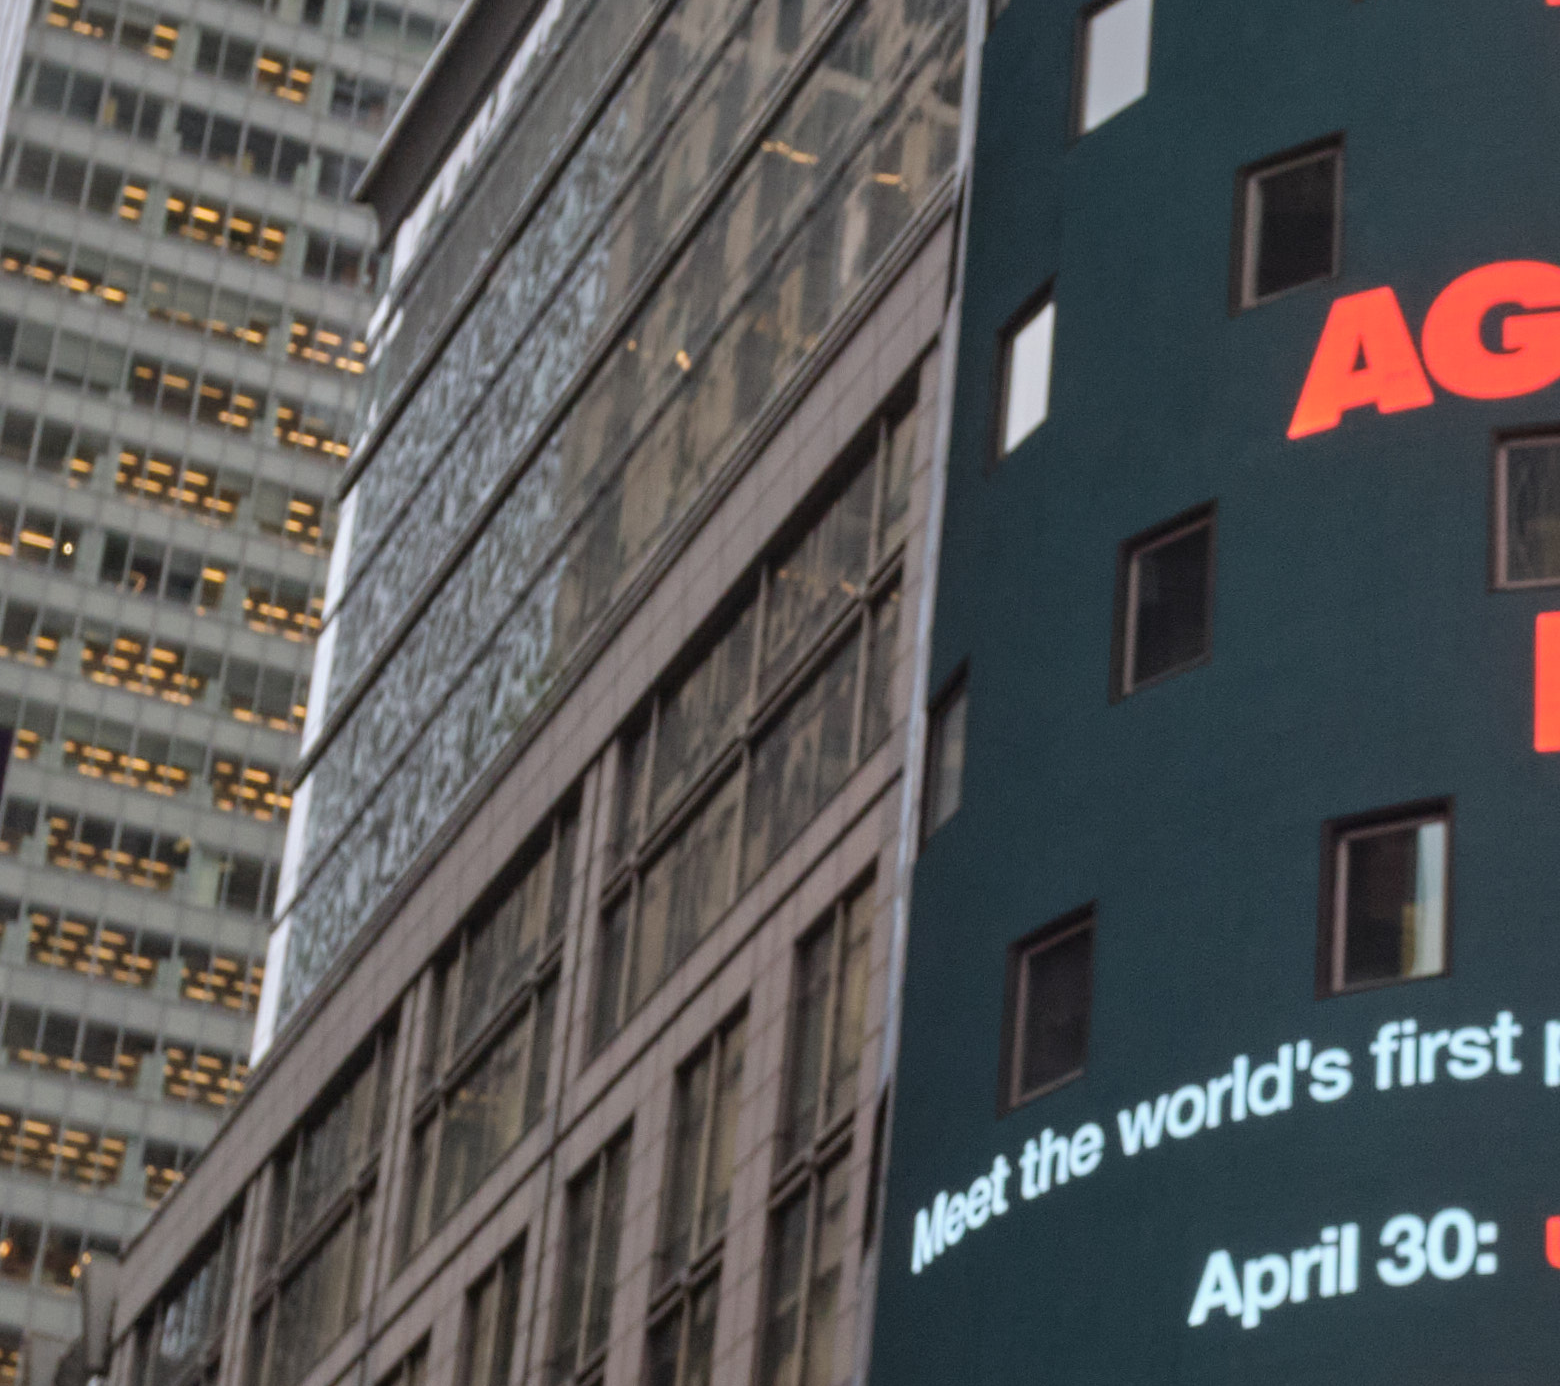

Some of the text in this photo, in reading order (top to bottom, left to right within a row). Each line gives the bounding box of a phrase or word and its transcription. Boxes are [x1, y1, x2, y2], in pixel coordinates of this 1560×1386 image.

[911, 1152, 1009, 1275] Meet
[1019, 1120, 1104, 1201] the
[1117, 1038, 1352, 1155] world's
[1372, 1010, 1523, 1091] first
[1188, 1221, 1359, 1328] April
[1377, 1208, 1499, 1288] 30:
